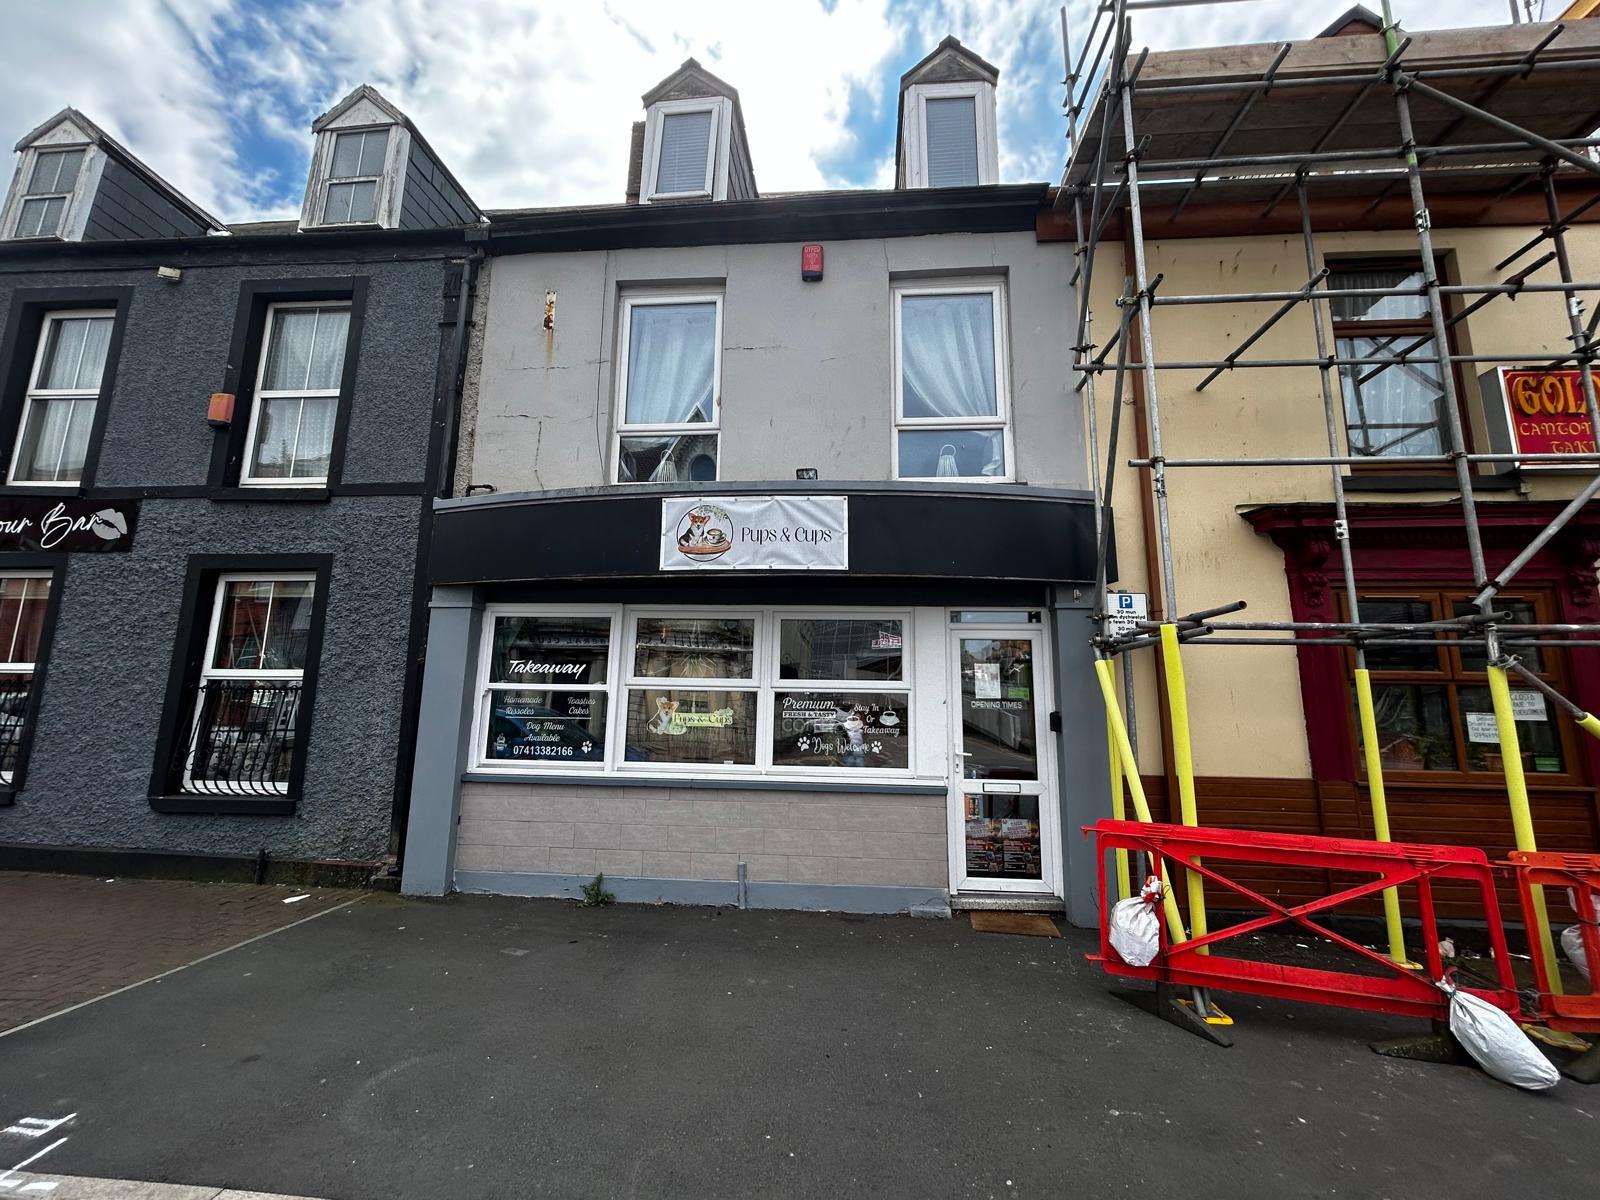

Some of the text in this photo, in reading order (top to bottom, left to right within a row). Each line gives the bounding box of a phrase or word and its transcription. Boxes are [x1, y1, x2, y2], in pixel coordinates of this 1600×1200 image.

[41, 502, 103, 549] Bar
[741, 526, 832, 545] Pups & Cups
[1122, 596, 1130, 608] P
[508, 660, 587, 680] Takeaway
[503, 695, 596, 705] Homemade Toasties
[782, 697, 835, 710] Premium
[505, 706, 590, 715] Rissoles Cakes
[815, 711, 835, 719] TASTY
[853, 703, 880, 715] Stay In
[674, 713, 695, 726] Pups
[708, 714, 733, 726] Cups
[865, 714, 876, 723] Or
[525, 721, 565, 731] Dog Menu
[862, 725, 901, 738] Takeaway
[523, 732, 561, 742] Available
[513, 745, 574, 756] 07413382166
[811, 736, 871, 756] Dogs Welcome
